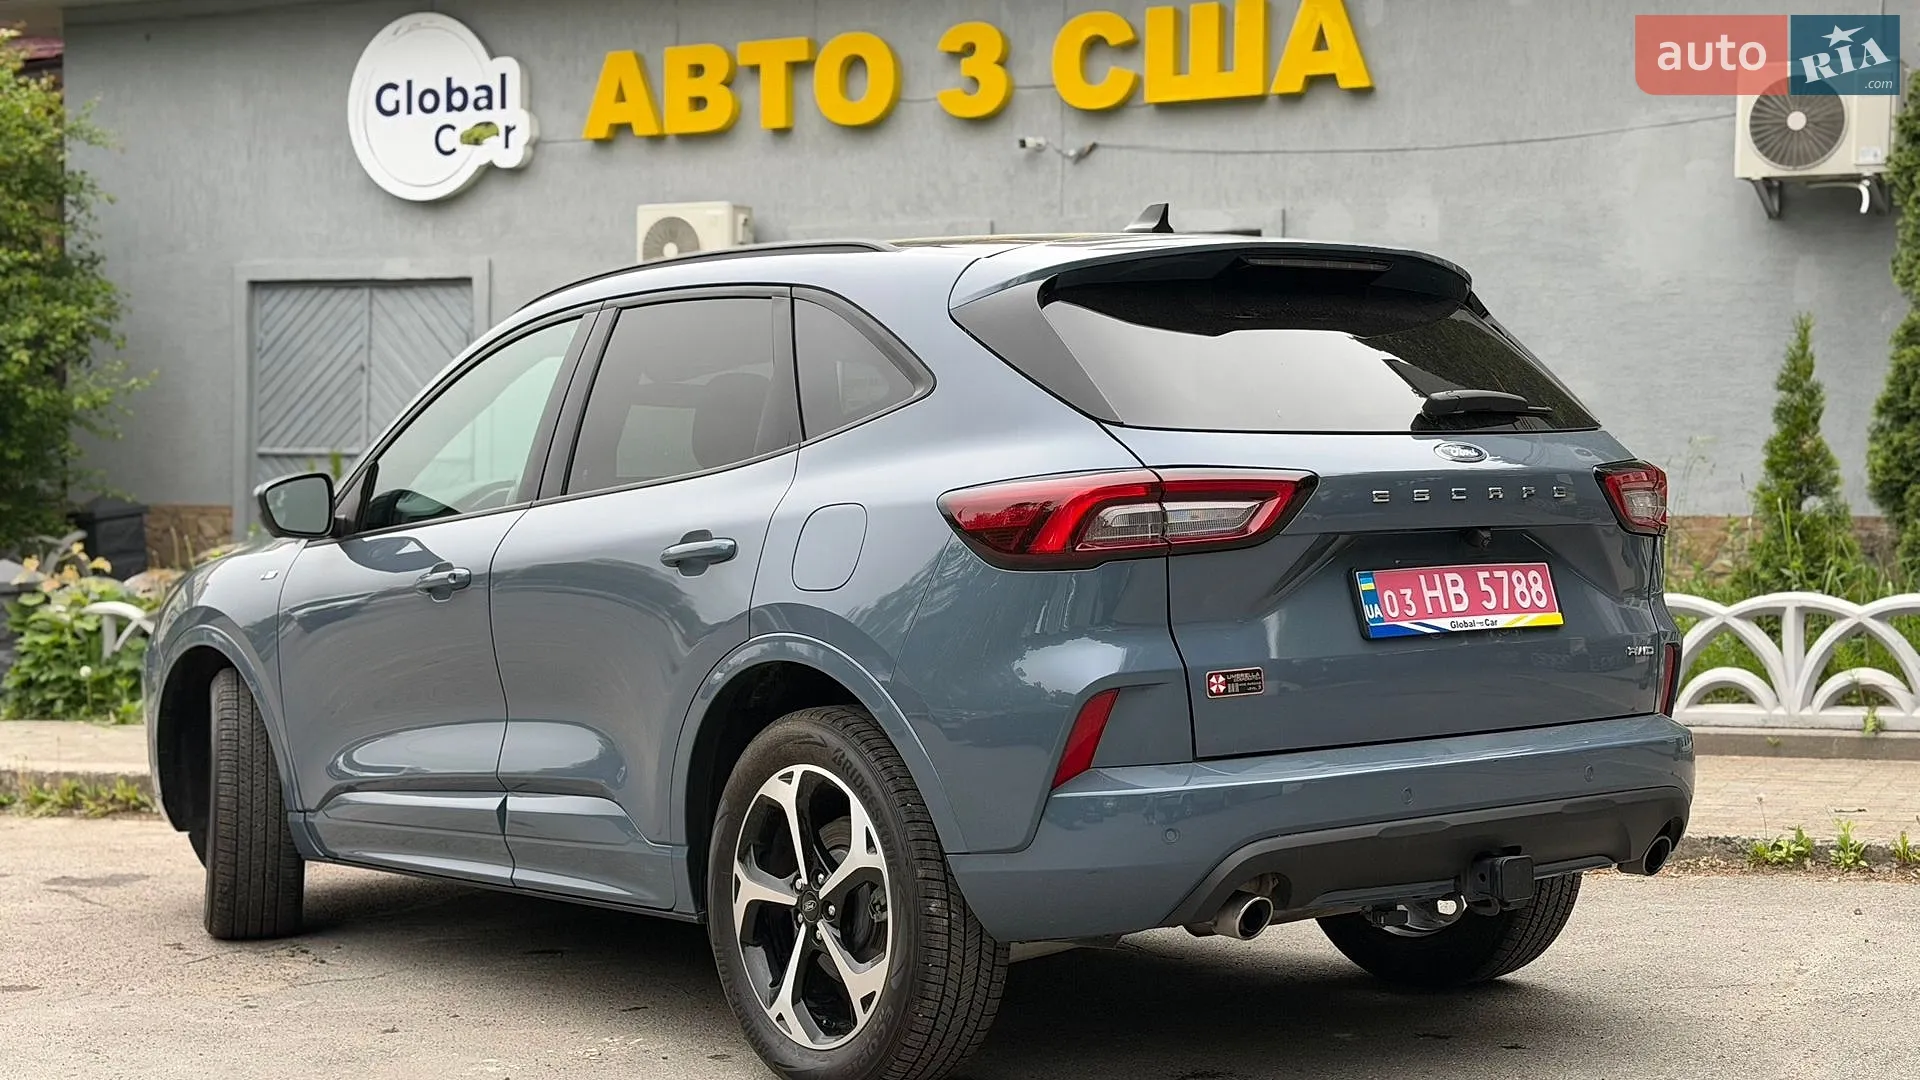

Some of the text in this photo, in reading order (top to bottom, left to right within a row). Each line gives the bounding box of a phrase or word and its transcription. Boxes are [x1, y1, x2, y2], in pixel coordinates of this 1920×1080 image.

[582, 32, 899, 142] АВТО
[1052, 0, 1375, 111] США
[375, 73, 507, 117] Global
[1372, 485, 1567, 503] ESCAPE
[1383, 569, 1547, 618] 03 HB 5788
[1365, 604, 1383, 619] UA
[1450, 618, 1498, 629] Global Car
